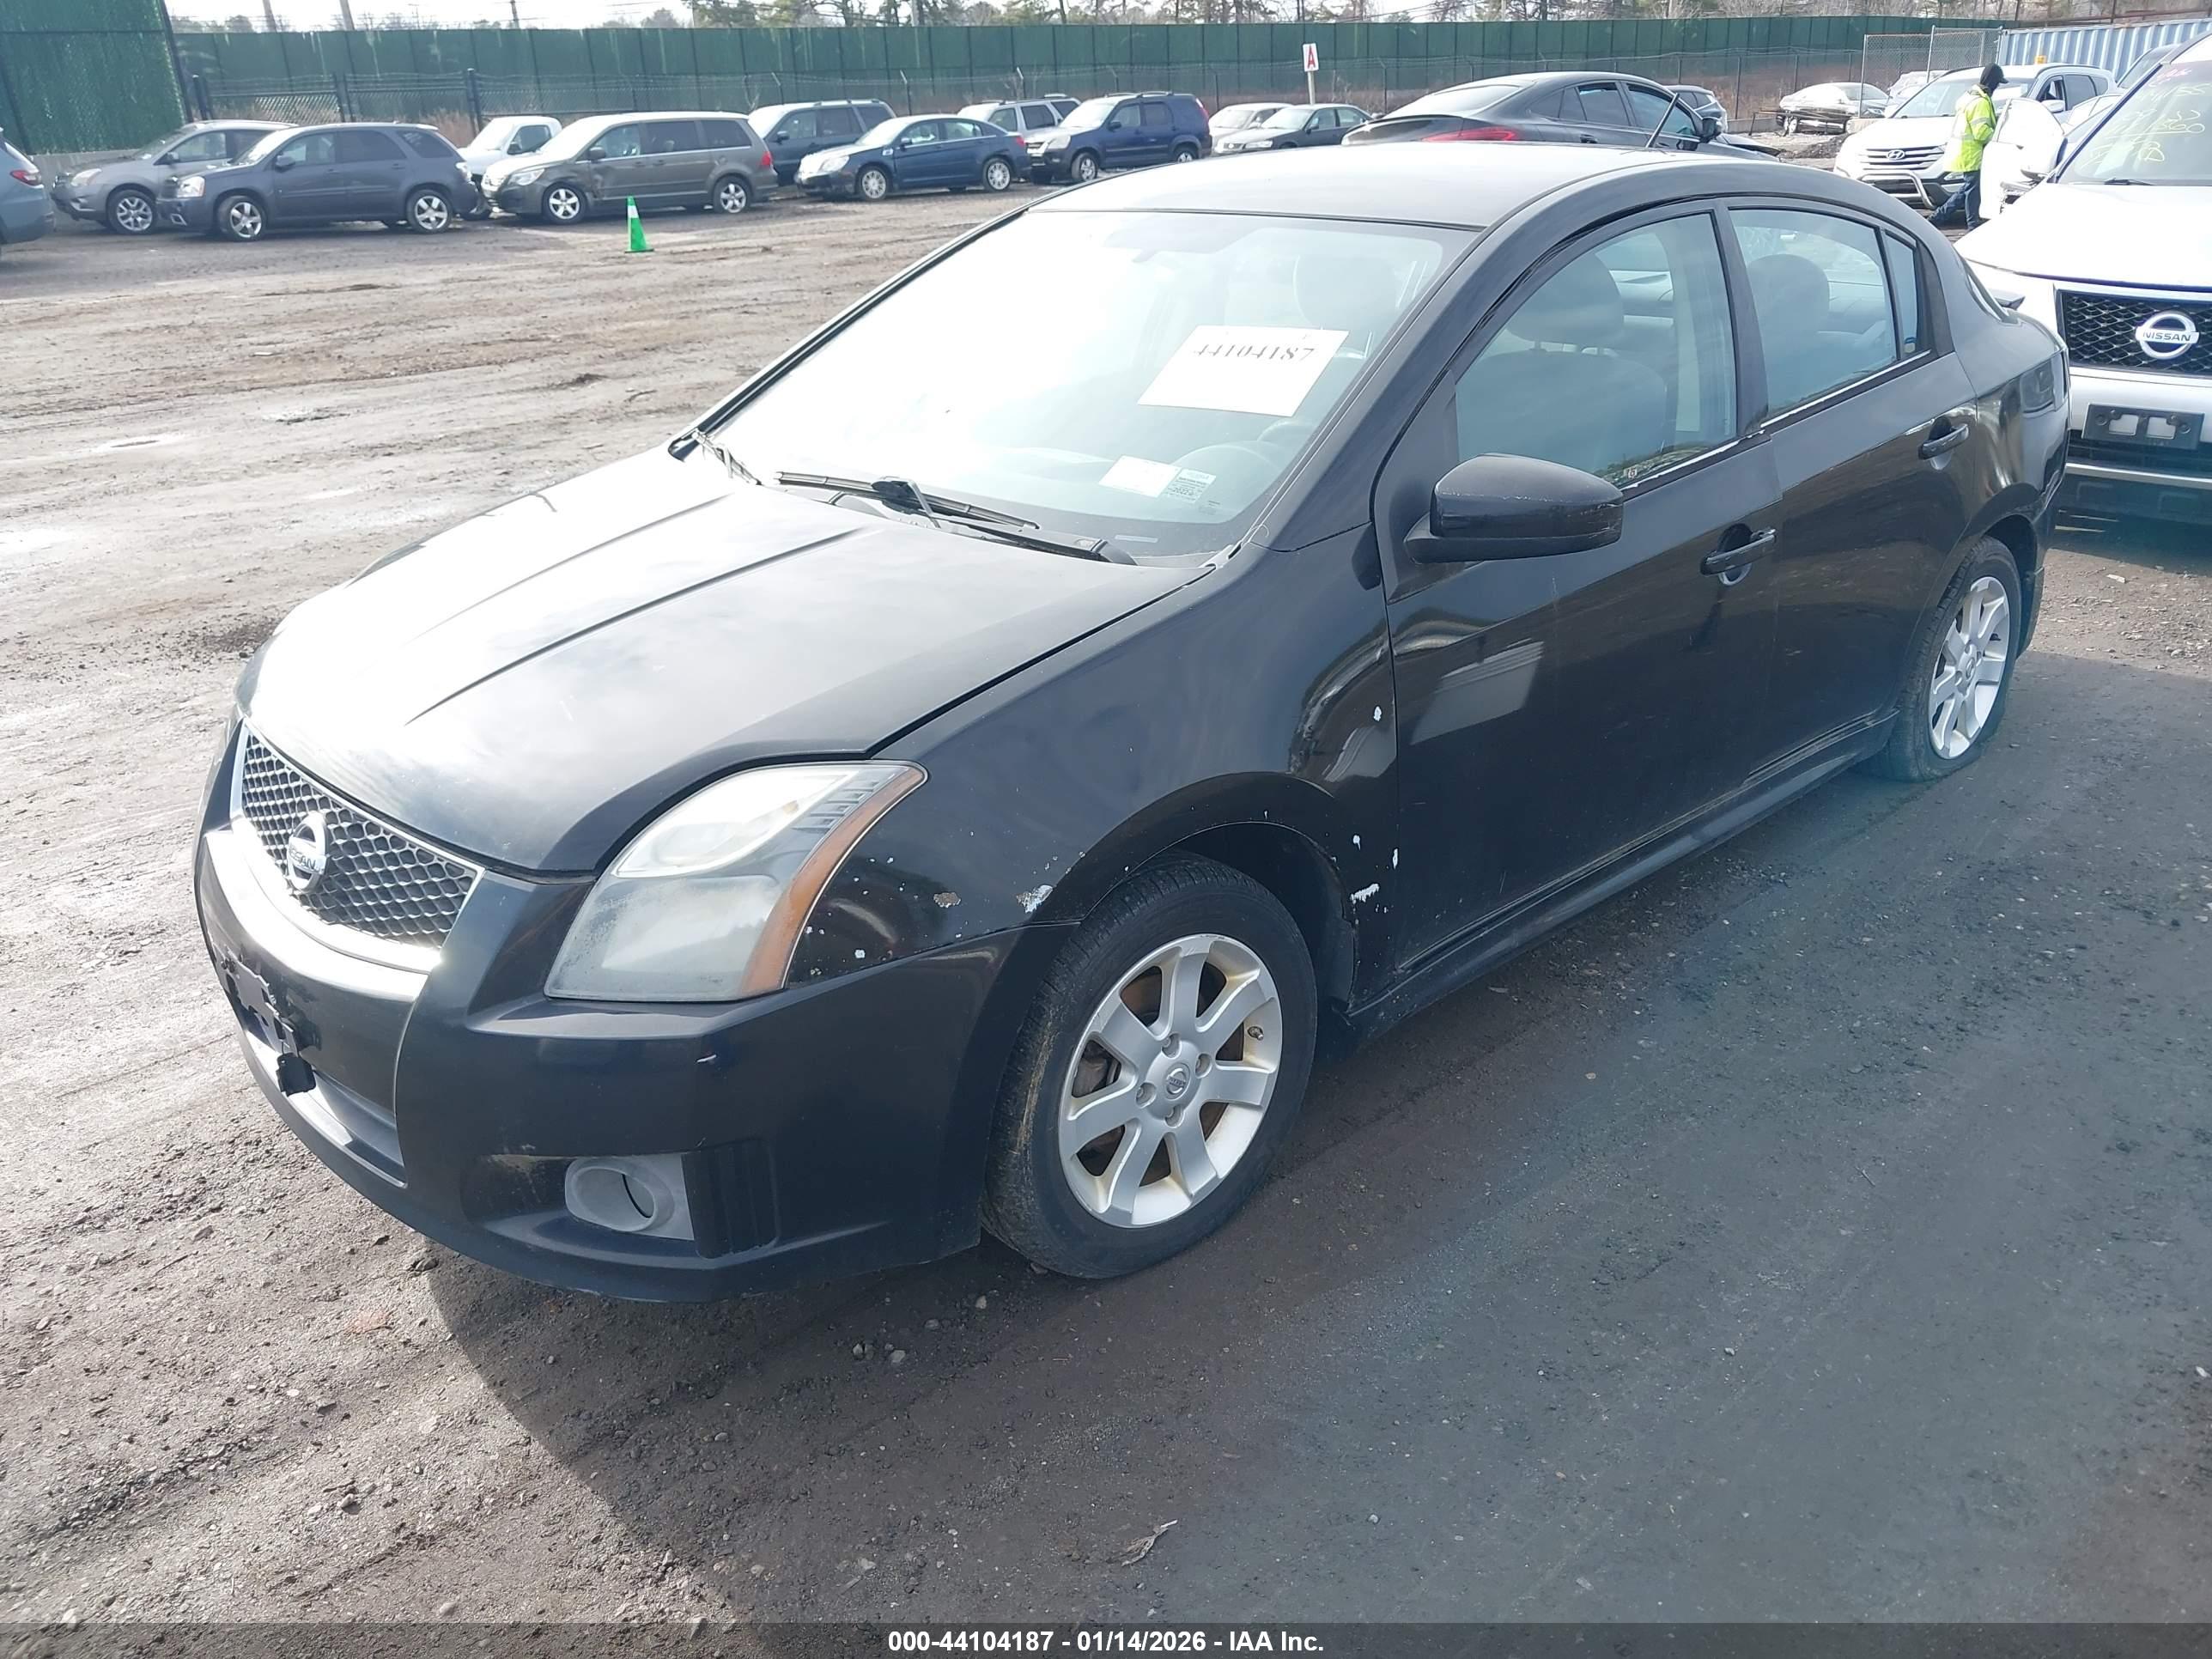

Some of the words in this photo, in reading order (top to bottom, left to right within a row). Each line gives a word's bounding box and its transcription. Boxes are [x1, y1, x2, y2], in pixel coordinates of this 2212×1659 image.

[1308, 45, 1316, 69] A
[2142, 330, 2191, 342] NISSAN
[1194, 344, 1316, 361] 44104187
[289, 847, 316, 870] SSAN
